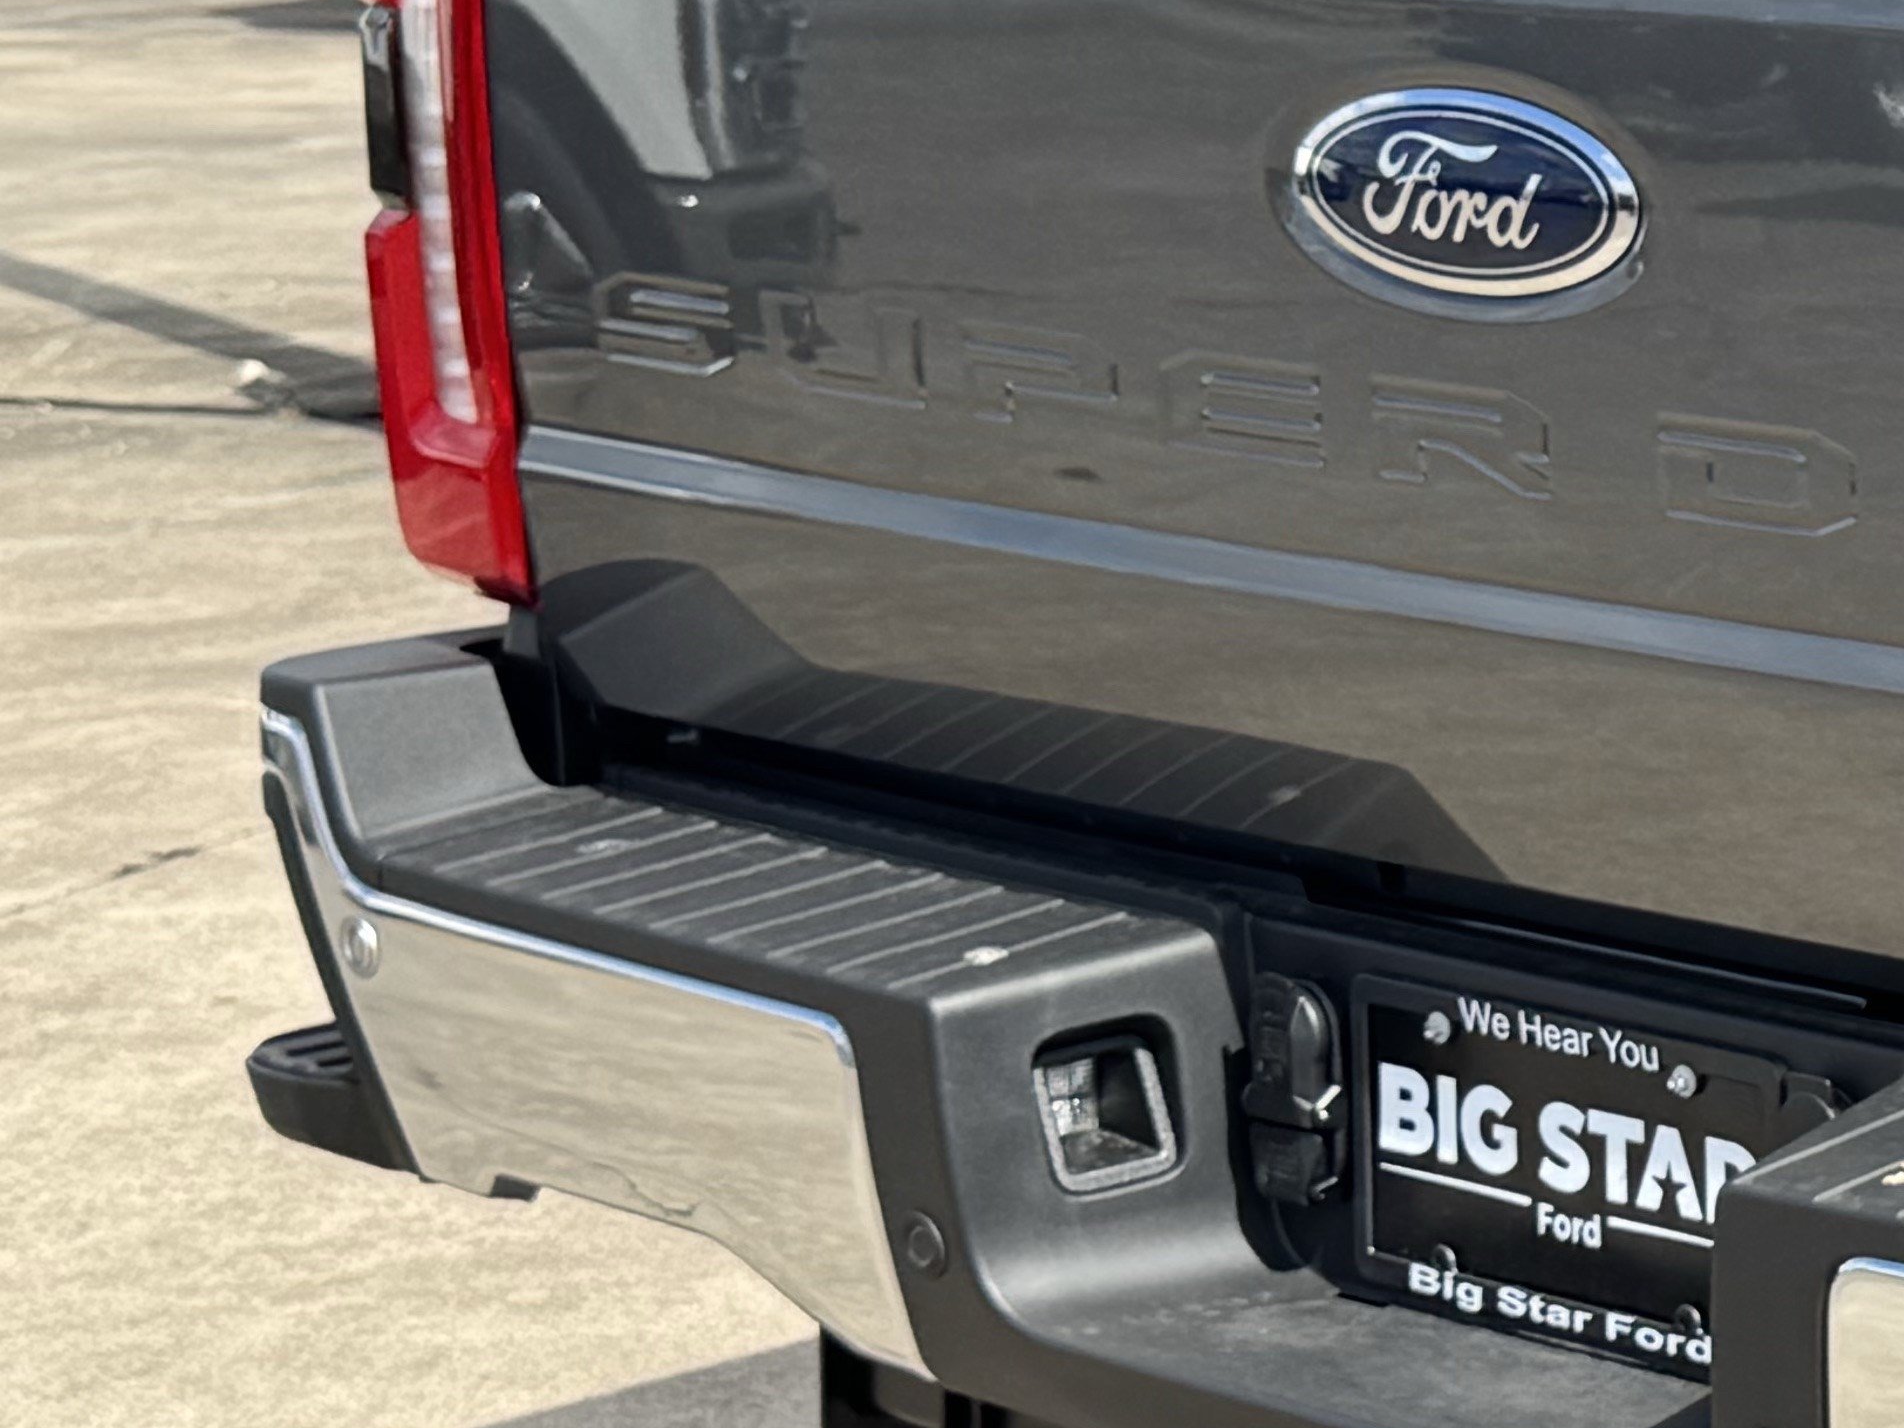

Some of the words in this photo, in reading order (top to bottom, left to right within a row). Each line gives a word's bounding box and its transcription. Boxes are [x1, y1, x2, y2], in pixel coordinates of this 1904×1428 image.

[1362, 130, 1543, 251] Ford
[597, 269, 1553, 502] SUPER
[1457, 996, 1511, 1041] We
[1517, 1009, 1594, 1058] Hear
[1598, 1026, 1660, 1072] You
[1378, 1062, 1519, 1176] BIG
[1536, 1201, 1602, 1249] Ford
[1408, 1261, 1484, 1313] Big
[1497, 1284, 1594, 1335] Star
[1605, 1311, 1713, 1365] Ford
